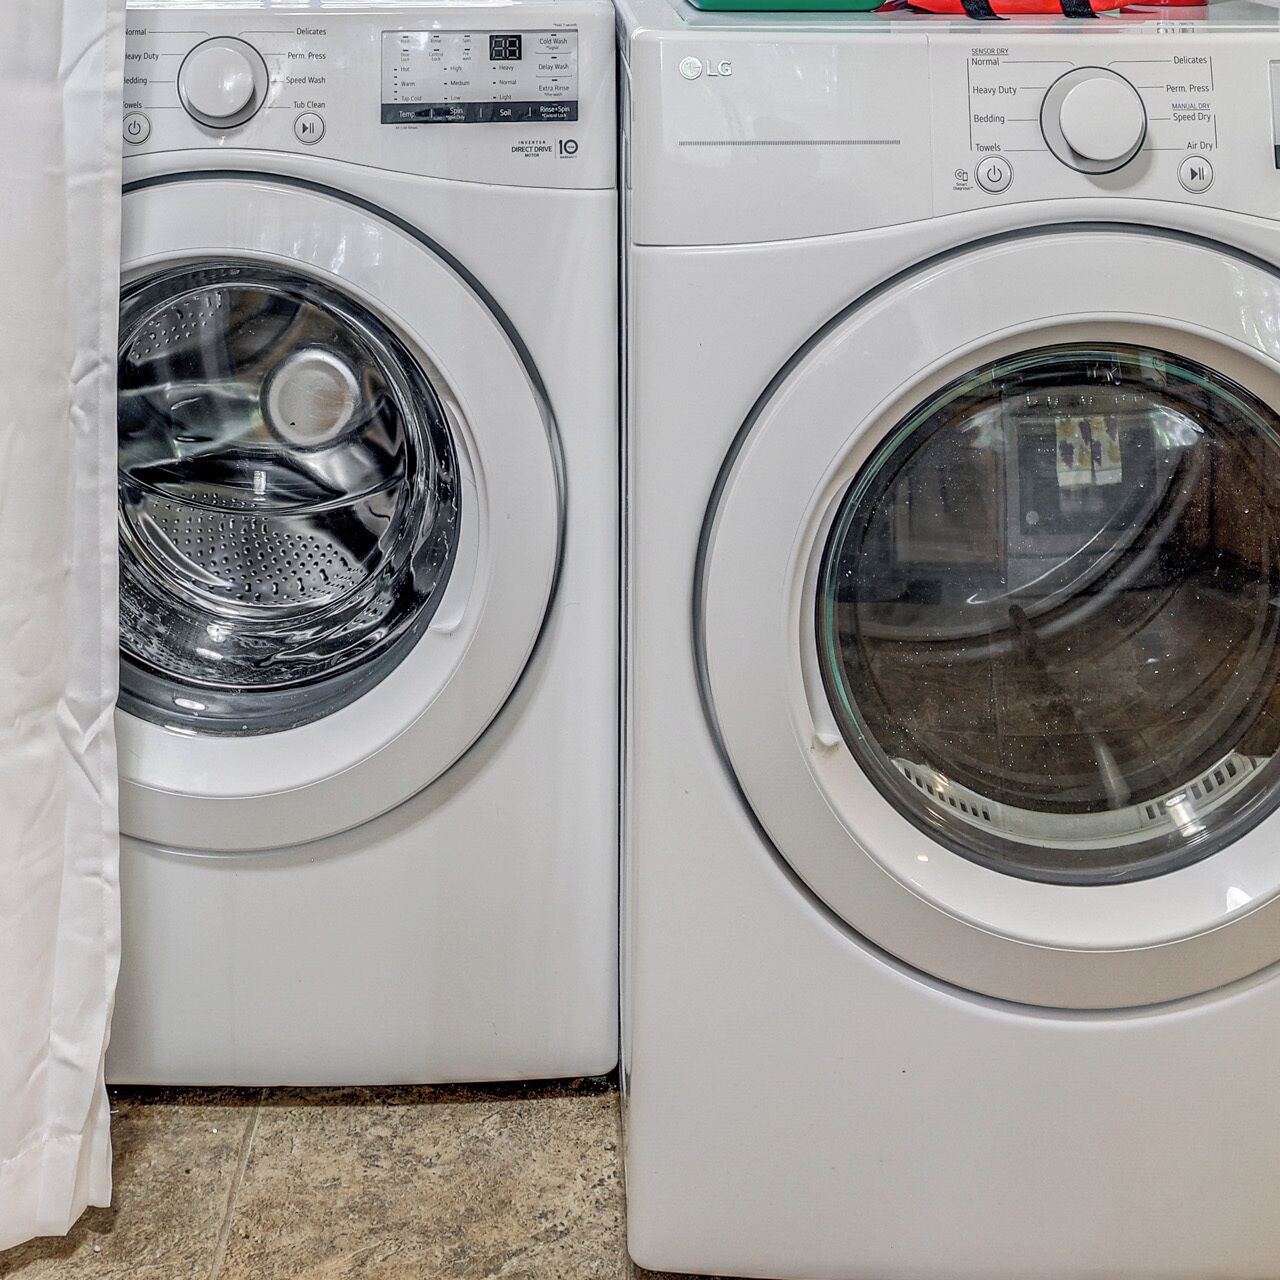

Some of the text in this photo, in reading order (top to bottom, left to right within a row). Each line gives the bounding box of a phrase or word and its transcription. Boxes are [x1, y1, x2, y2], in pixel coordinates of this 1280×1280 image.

[296, 27, 327, 36] Delicates
[143, 52, 159, 61] Duty
[288, 52, 326, 60] Perm. Press
[1173, 56, 1208, 65] Delicates
[971, 58, 1000, 66] Normal
[706, 59, 732, 77] LG
[286, 76, 326, 86] Speed Wash
[972, 85, 1017, 96] Heavy Duty
[1166, 84, 1210, 93] Perm. Press
[449, 107, 463, 115] Spin
[540, 106, 570, 114] Rinse+Spin
[399, 111, 415, 119] Temp
[973, 114, 1005, 124] Bedding
[1173, 113, 1211, 123] Speed Dry
[558, 139, 579, 155] 10
[975, 143, 1002, 152] Towels
[1186, 141, 1213, 151] Air Dry
